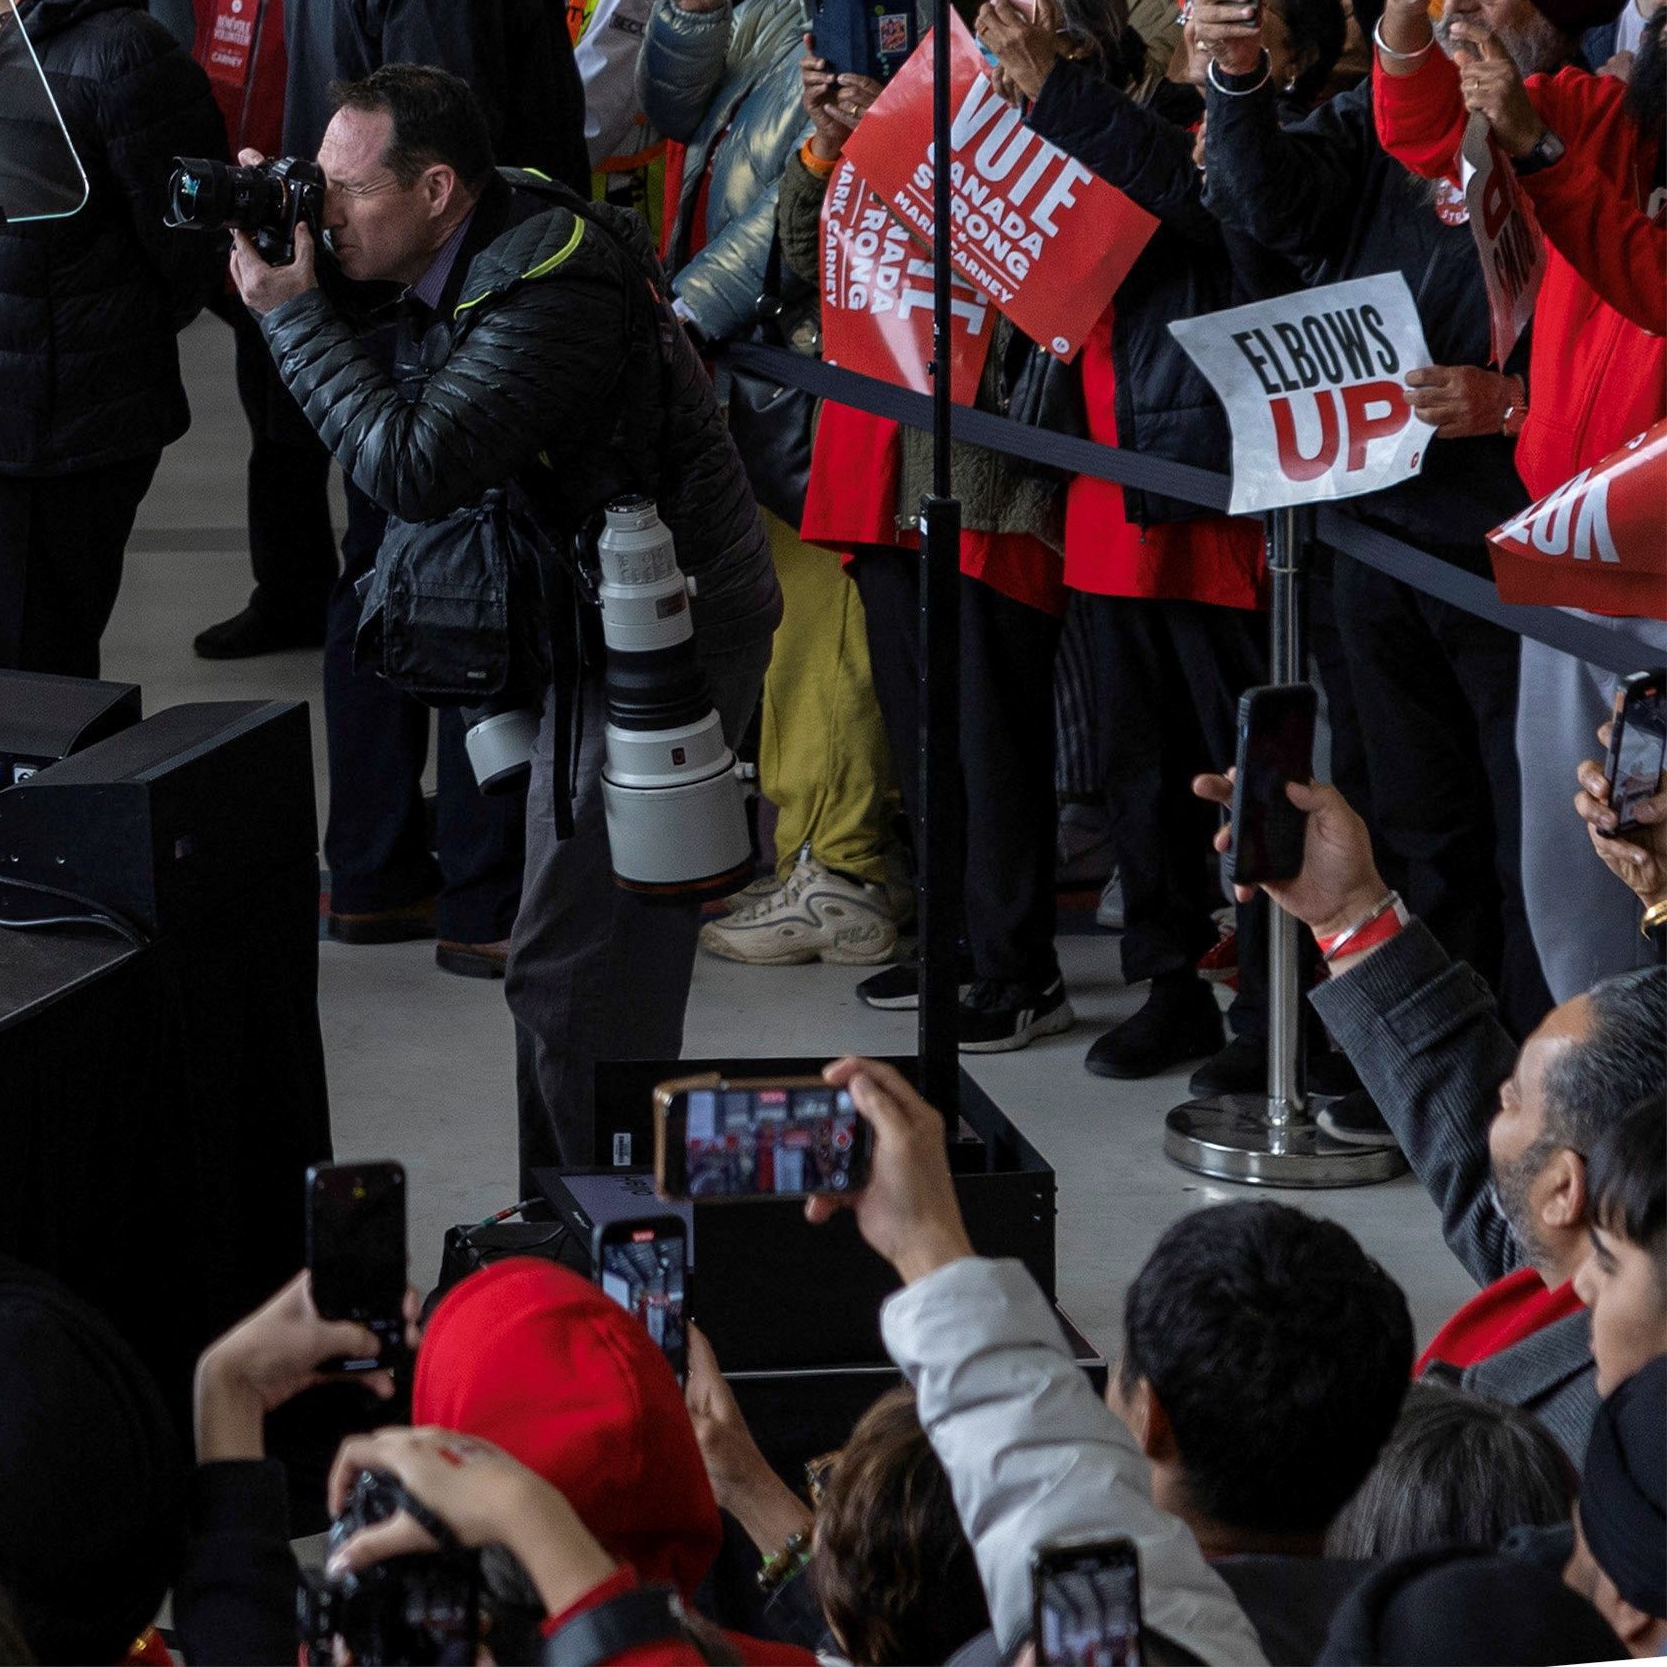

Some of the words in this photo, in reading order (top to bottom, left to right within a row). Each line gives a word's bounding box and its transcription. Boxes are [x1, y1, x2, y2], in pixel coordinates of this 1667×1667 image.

[913, 158, 1031, 284] SRONG
[928, 142, 1045, 262] ANADA
[952, 251, 1014, 307] ARNEY
[1231, 304, 1401, 395] ELBOWS
[1269, 380, 1412, 483] UP
